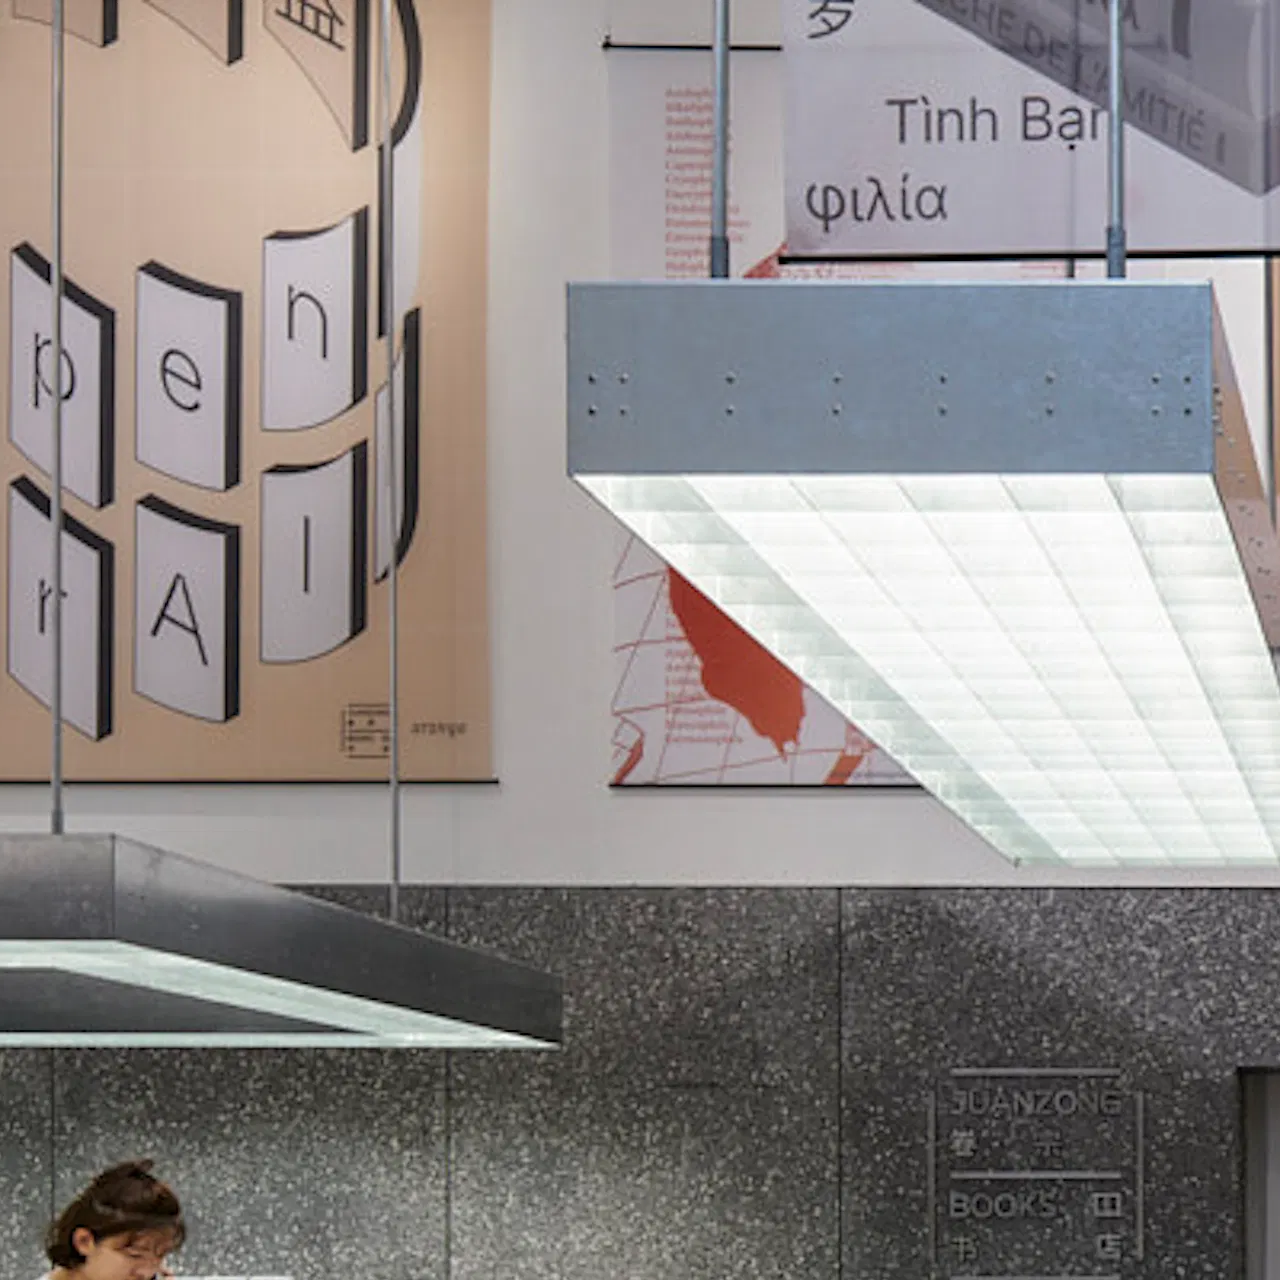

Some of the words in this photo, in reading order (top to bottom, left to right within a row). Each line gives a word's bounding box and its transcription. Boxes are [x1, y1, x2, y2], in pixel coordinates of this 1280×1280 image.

[886, 97, 998, 142] Tình
[805, 172, 949, 233] φιλία
[950, 1088, 1122, 1116] JUANZONG
[949, 1190, 1057, 1219] BOOKS
